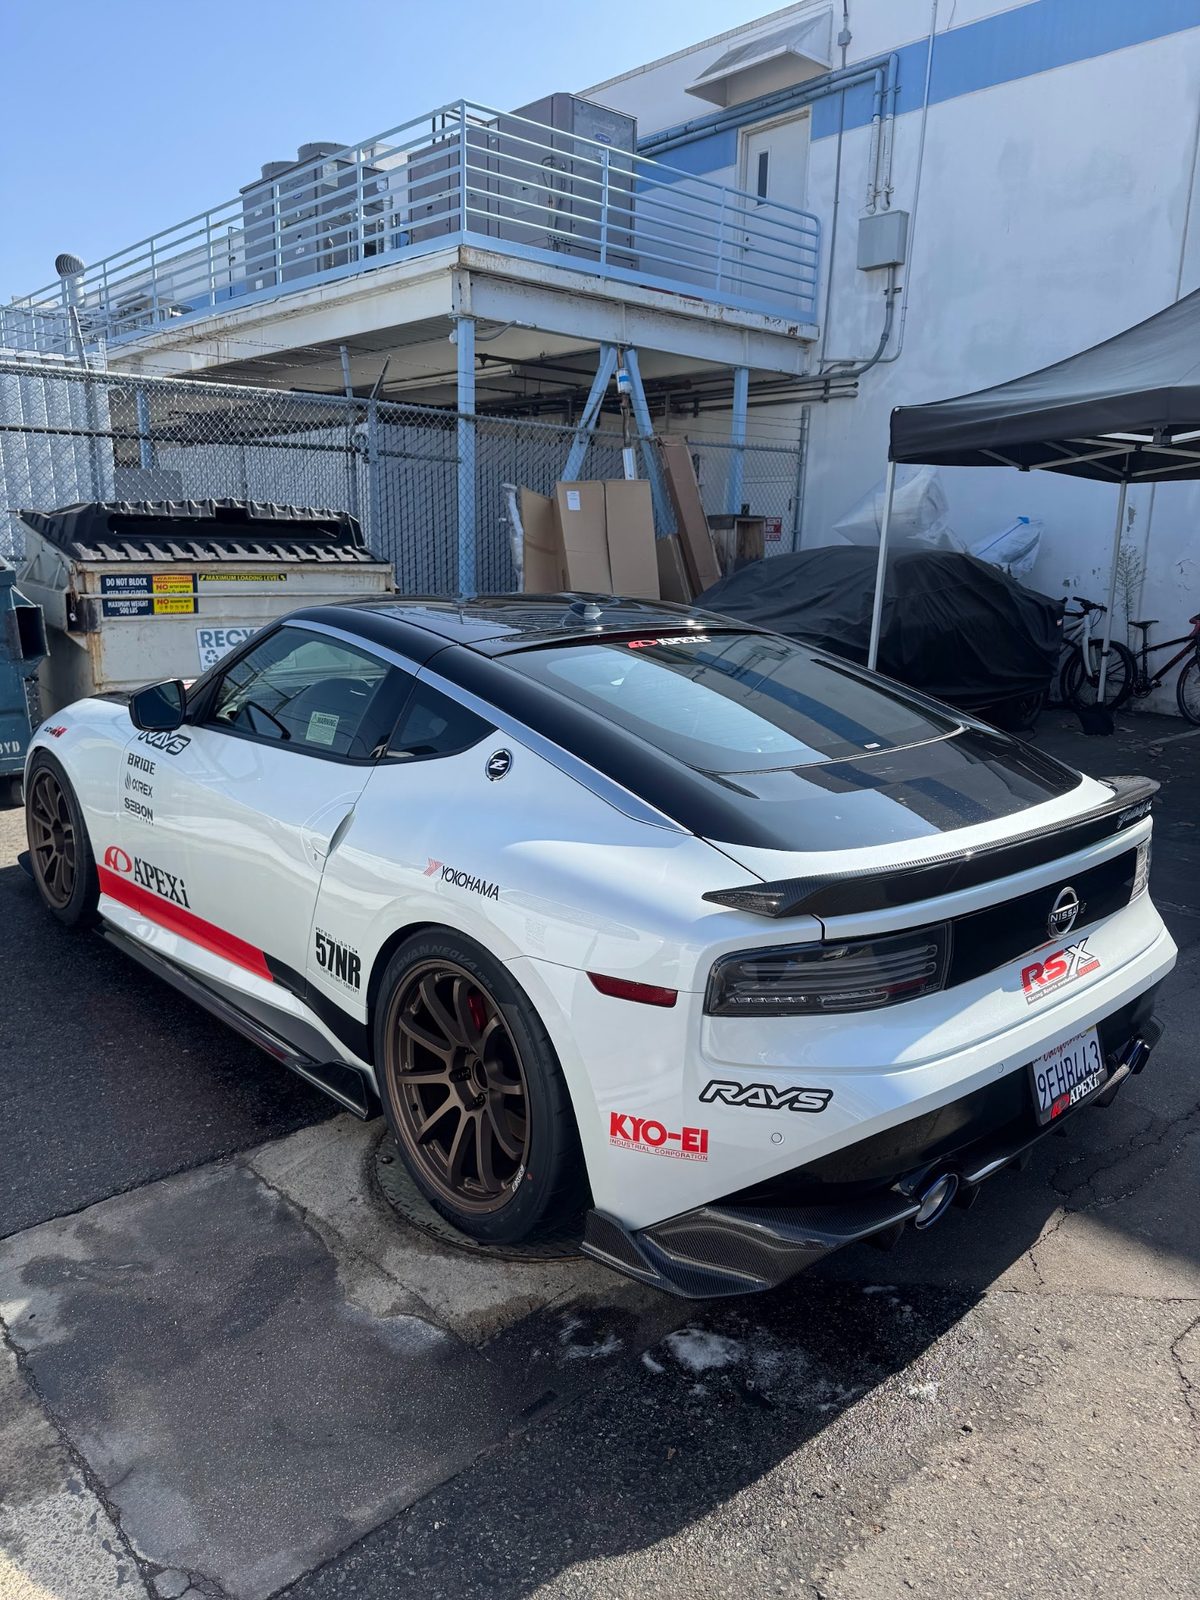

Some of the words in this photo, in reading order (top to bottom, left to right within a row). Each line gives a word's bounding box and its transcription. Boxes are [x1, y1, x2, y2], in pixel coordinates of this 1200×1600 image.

[106, 578, 115, 586] DO
[115, 578, 128, 586] NOT
[128, 578, 148, 586] BLOCK
[107, 600, 130, 608] MAXIMUM
[127, 752, 156, 775] BRIDE
[124, 797, 154, 821] SEBON
[441, 865, 500, 901] YOKOHAMA
[1050, 904, 1079, 923] NISSA
[316, 931, 361, 990] 57NR
[1021, 936, 1095, 993] RSX
[1037, 1040, 1100, 1111] 9EHB443
[698, 1079, 834, 1113] RAYS
[609, 1111, 709, 1153] KYO-EI
[609, 1138, 650, 1152] INDUSTRIAL
[654, 1147, 708, 1161] CORPORATION
